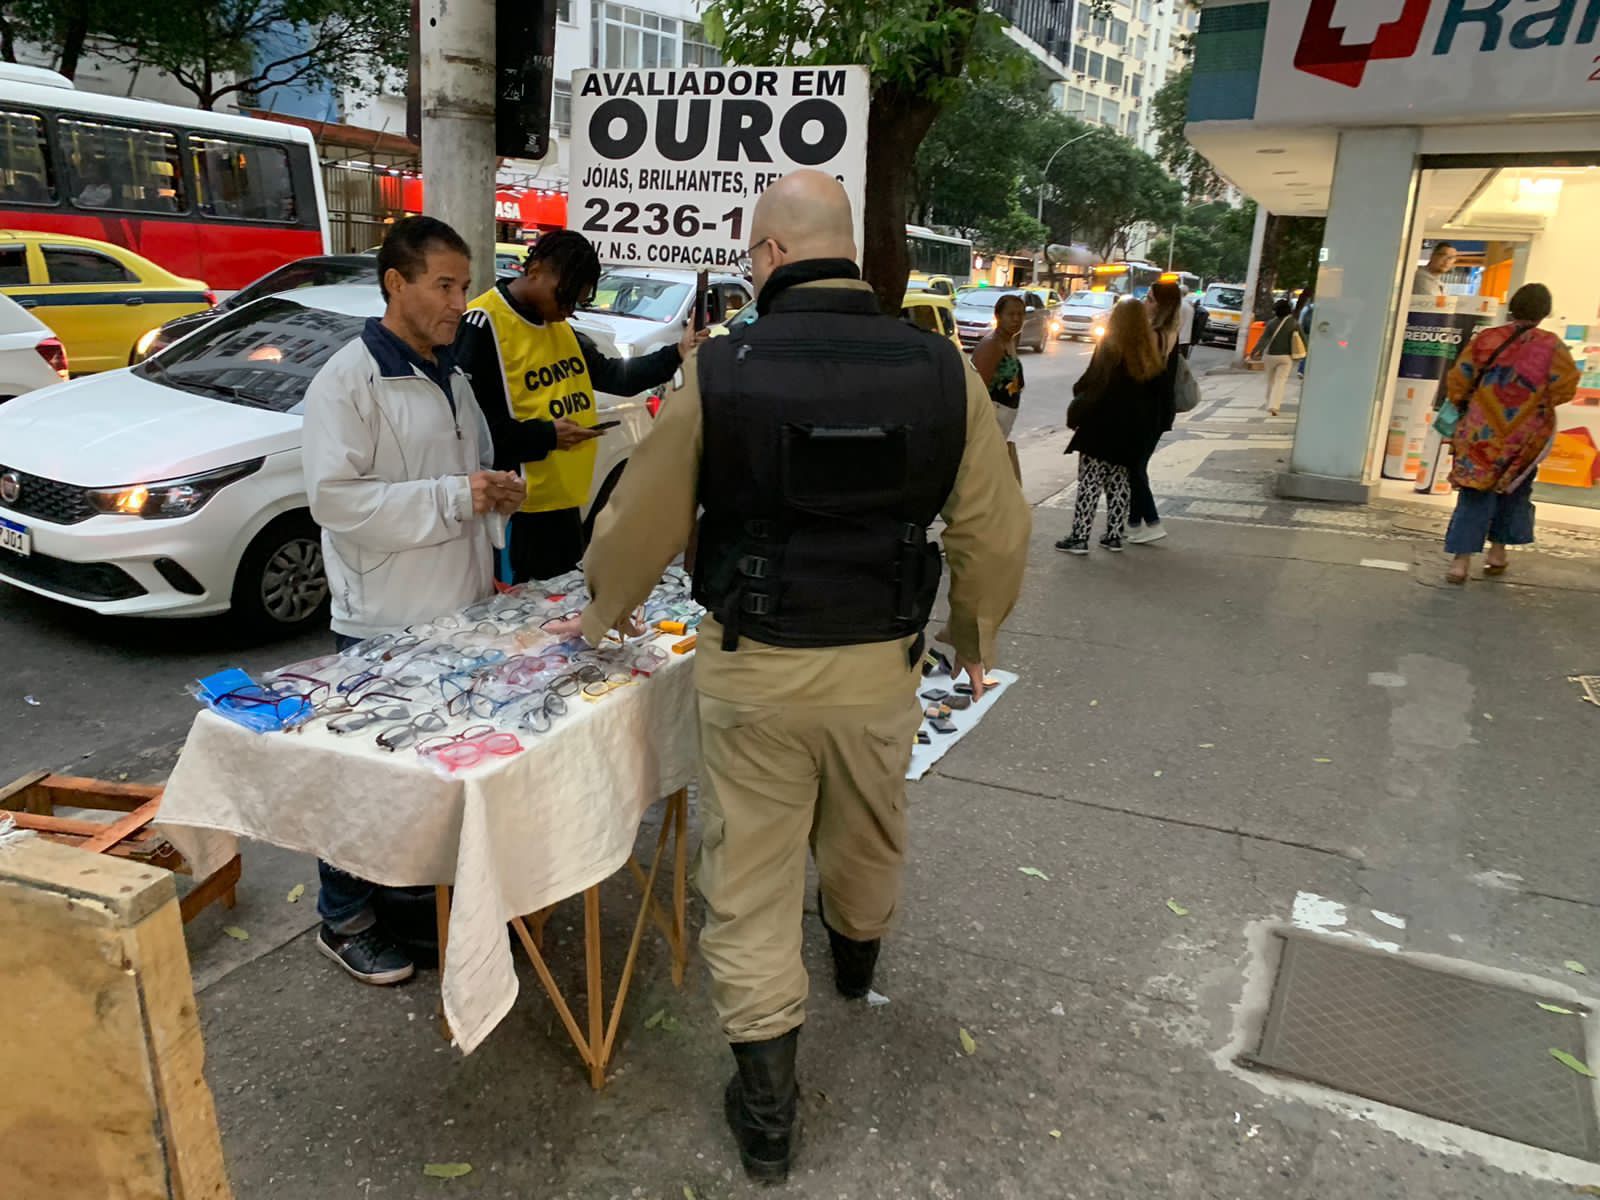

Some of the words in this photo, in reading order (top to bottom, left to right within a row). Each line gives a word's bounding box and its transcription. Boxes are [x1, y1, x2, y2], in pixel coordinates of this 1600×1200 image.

[581, 71, 778, 97] AVALIADOR
[792, 70, 847, 96] EM
[588, 97, 848, 166] OURO
[582, 162, 633, 194] JÓIAS,
[638, 168, 748, 198] BRILHANTES,
[495, 200, 521, 220] ASA
[582, 197, 744, 240] 2236-1
[591, 240, 604, 259] V.
[609, 241, 641, 261] N.S.
[647, 244, 744, 268] COPACABA
[548, 391, 591, 419] OURO
